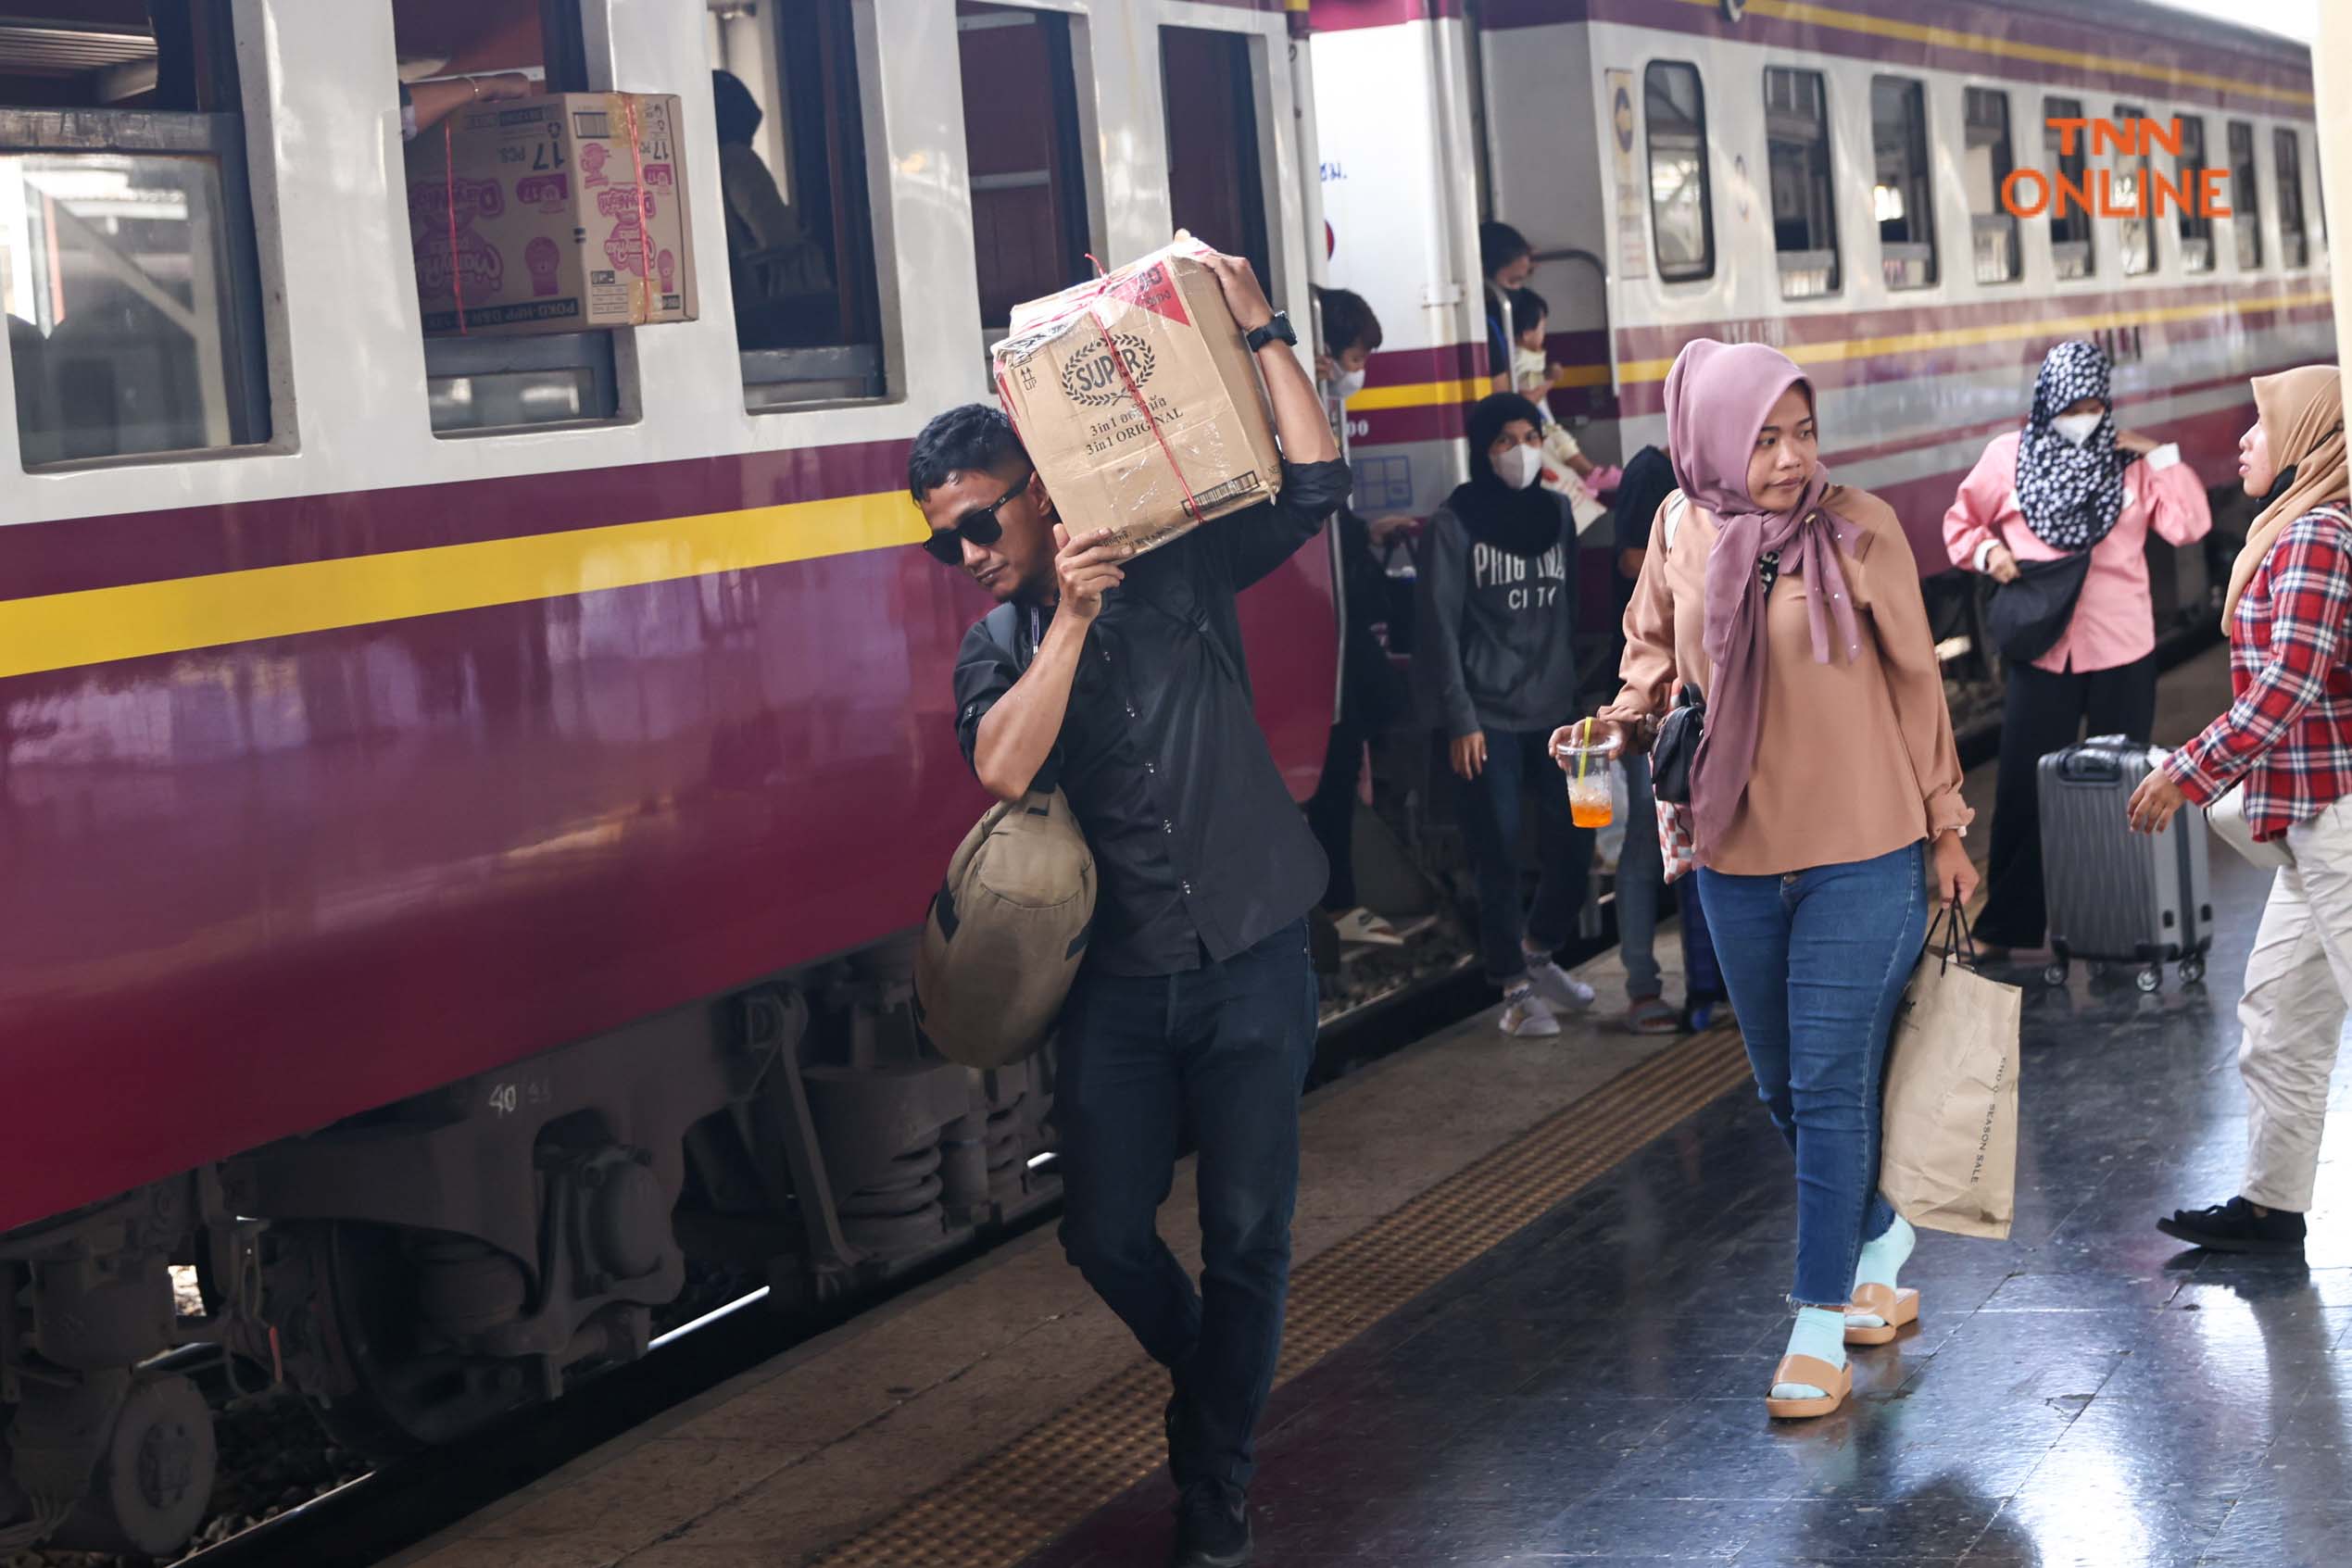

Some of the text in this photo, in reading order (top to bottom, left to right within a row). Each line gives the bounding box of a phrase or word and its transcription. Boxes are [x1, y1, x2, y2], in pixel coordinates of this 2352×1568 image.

[533, 143, 565, 170] 17
[652, 141, 670, 161] 17
[1023, 379, 1038, 393] UP
[1116, 408, 1184, 443] ORIGNAL
[1508, 585, 1557, 610] CITY
[1979, 1103, 1996, 1151] SEASON
[1970, 1154, 1984, 1184] SALE
